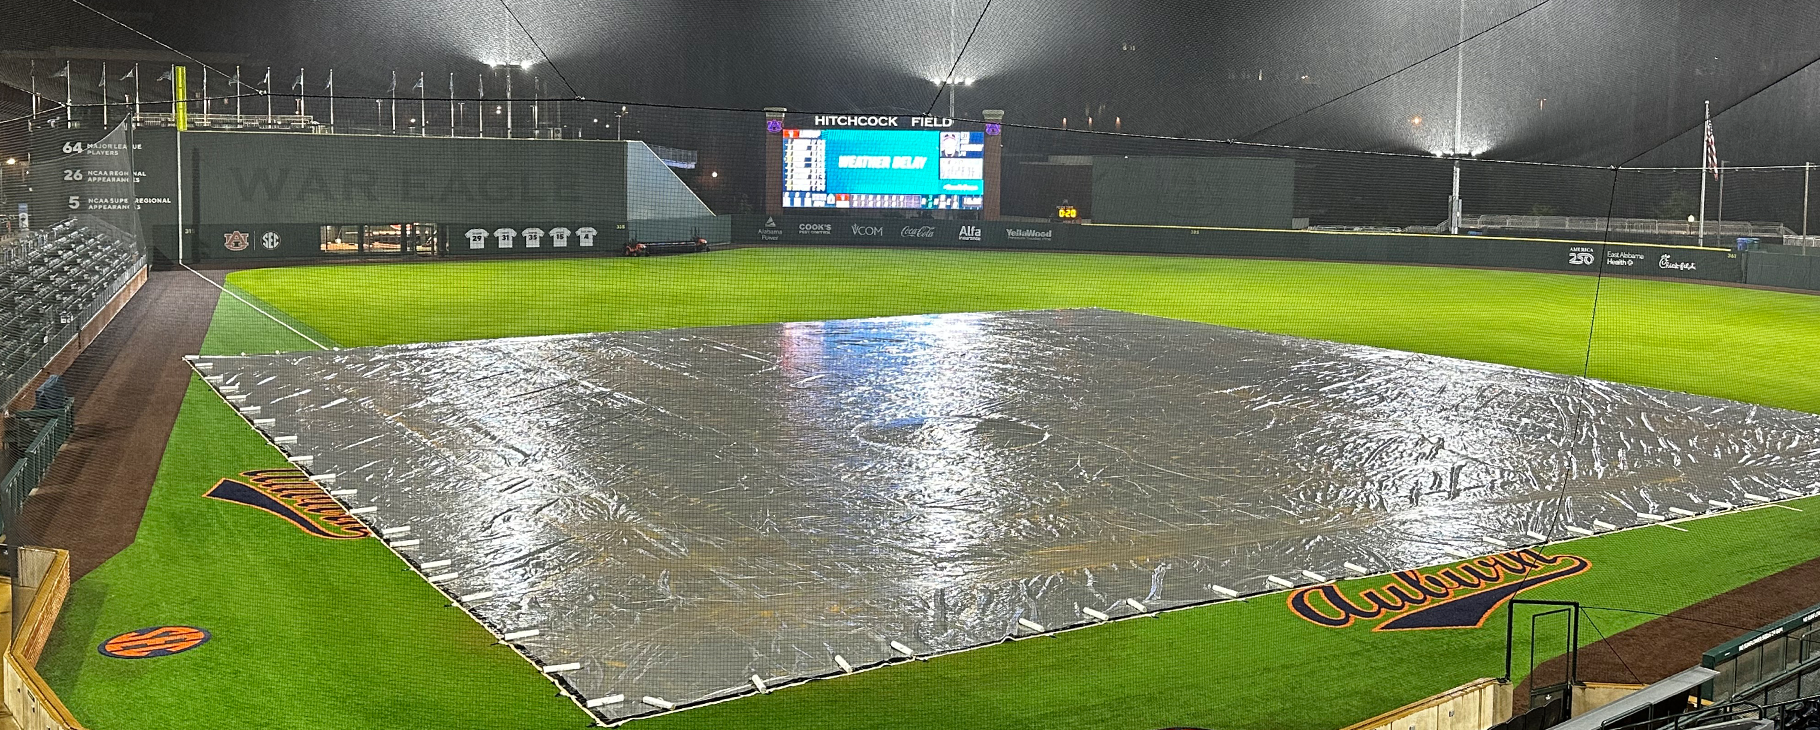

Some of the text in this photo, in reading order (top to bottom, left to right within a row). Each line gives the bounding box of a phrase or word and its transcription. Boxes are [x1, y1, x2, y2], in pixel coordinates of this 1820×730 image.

[815, 116, 953, 127] HITCHCOCK FIELD
[62, 142, 83, 154] 64
[838, 155, 891, 169] WEATHER
[892, 155, 928, 169] DELAY
[64, 169, 83, 181] 26
[68, 196, 80, 209] 5
[959, 225, 982, 237] Alfa
[261, 231, 280, 249] SEC
[1568, 252, 1595, 266] 250
[1607, 258, 1627, 266] Health
[1287, 548, 1590, 630] Auburn
